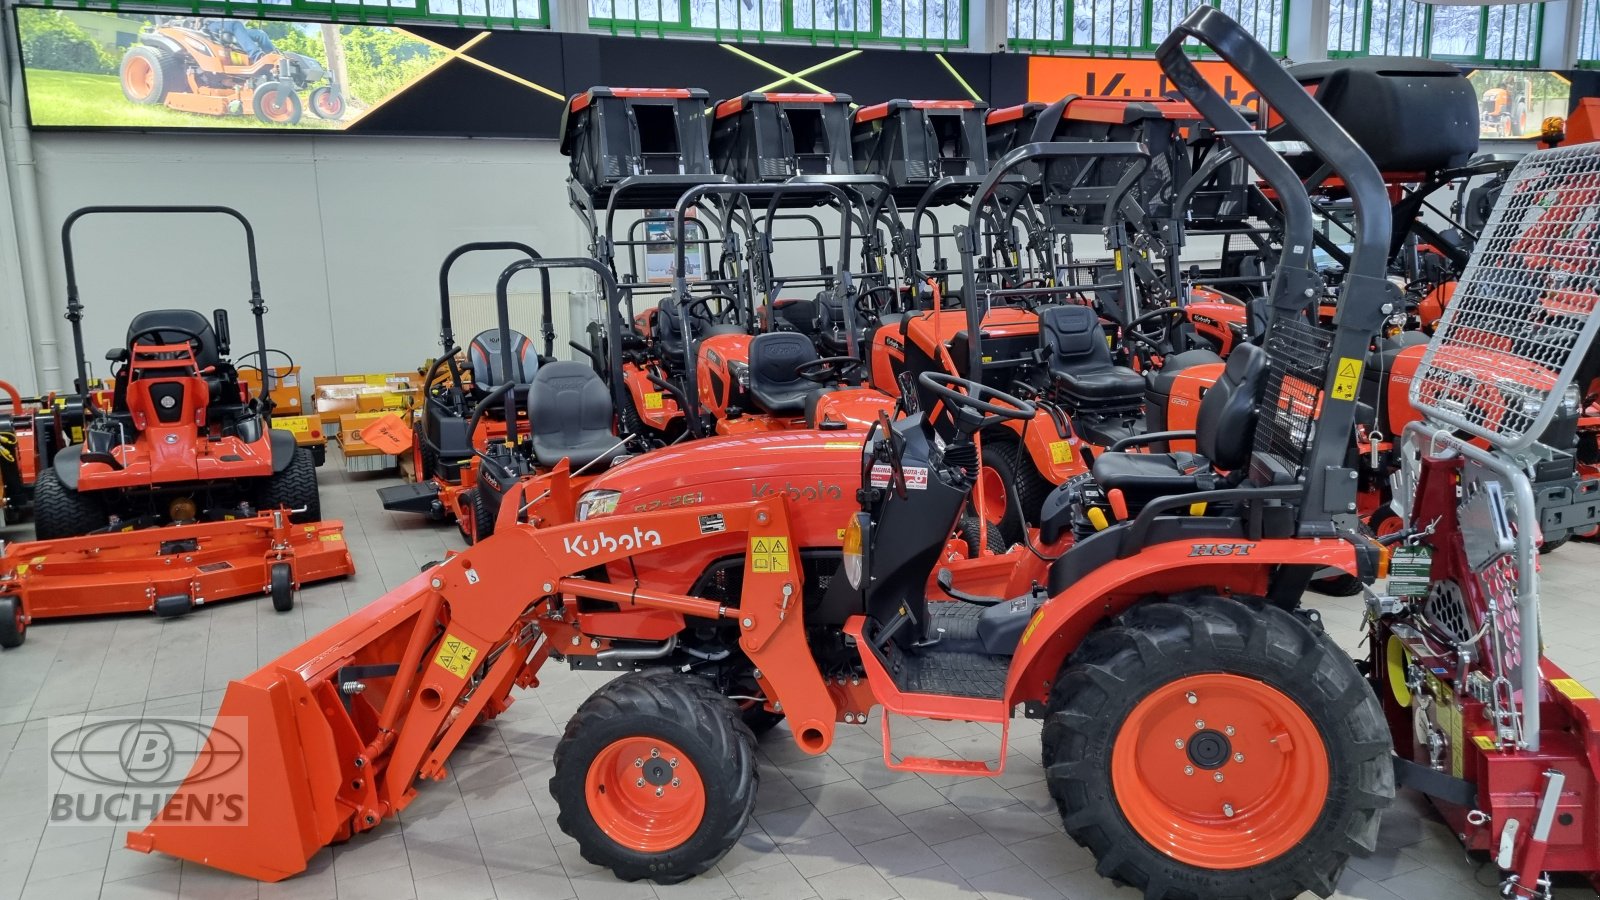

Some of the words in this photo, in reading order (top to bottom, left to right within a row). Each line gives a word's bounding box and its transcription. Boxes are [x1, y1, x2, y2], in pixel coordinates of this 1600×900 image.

[1193, 314, 1211, 325] Kubota
[1171, 396, 1189, 407] G261
[563, 526, 662, 557] Kubota
[1187, 543, 1256, 557] HST
